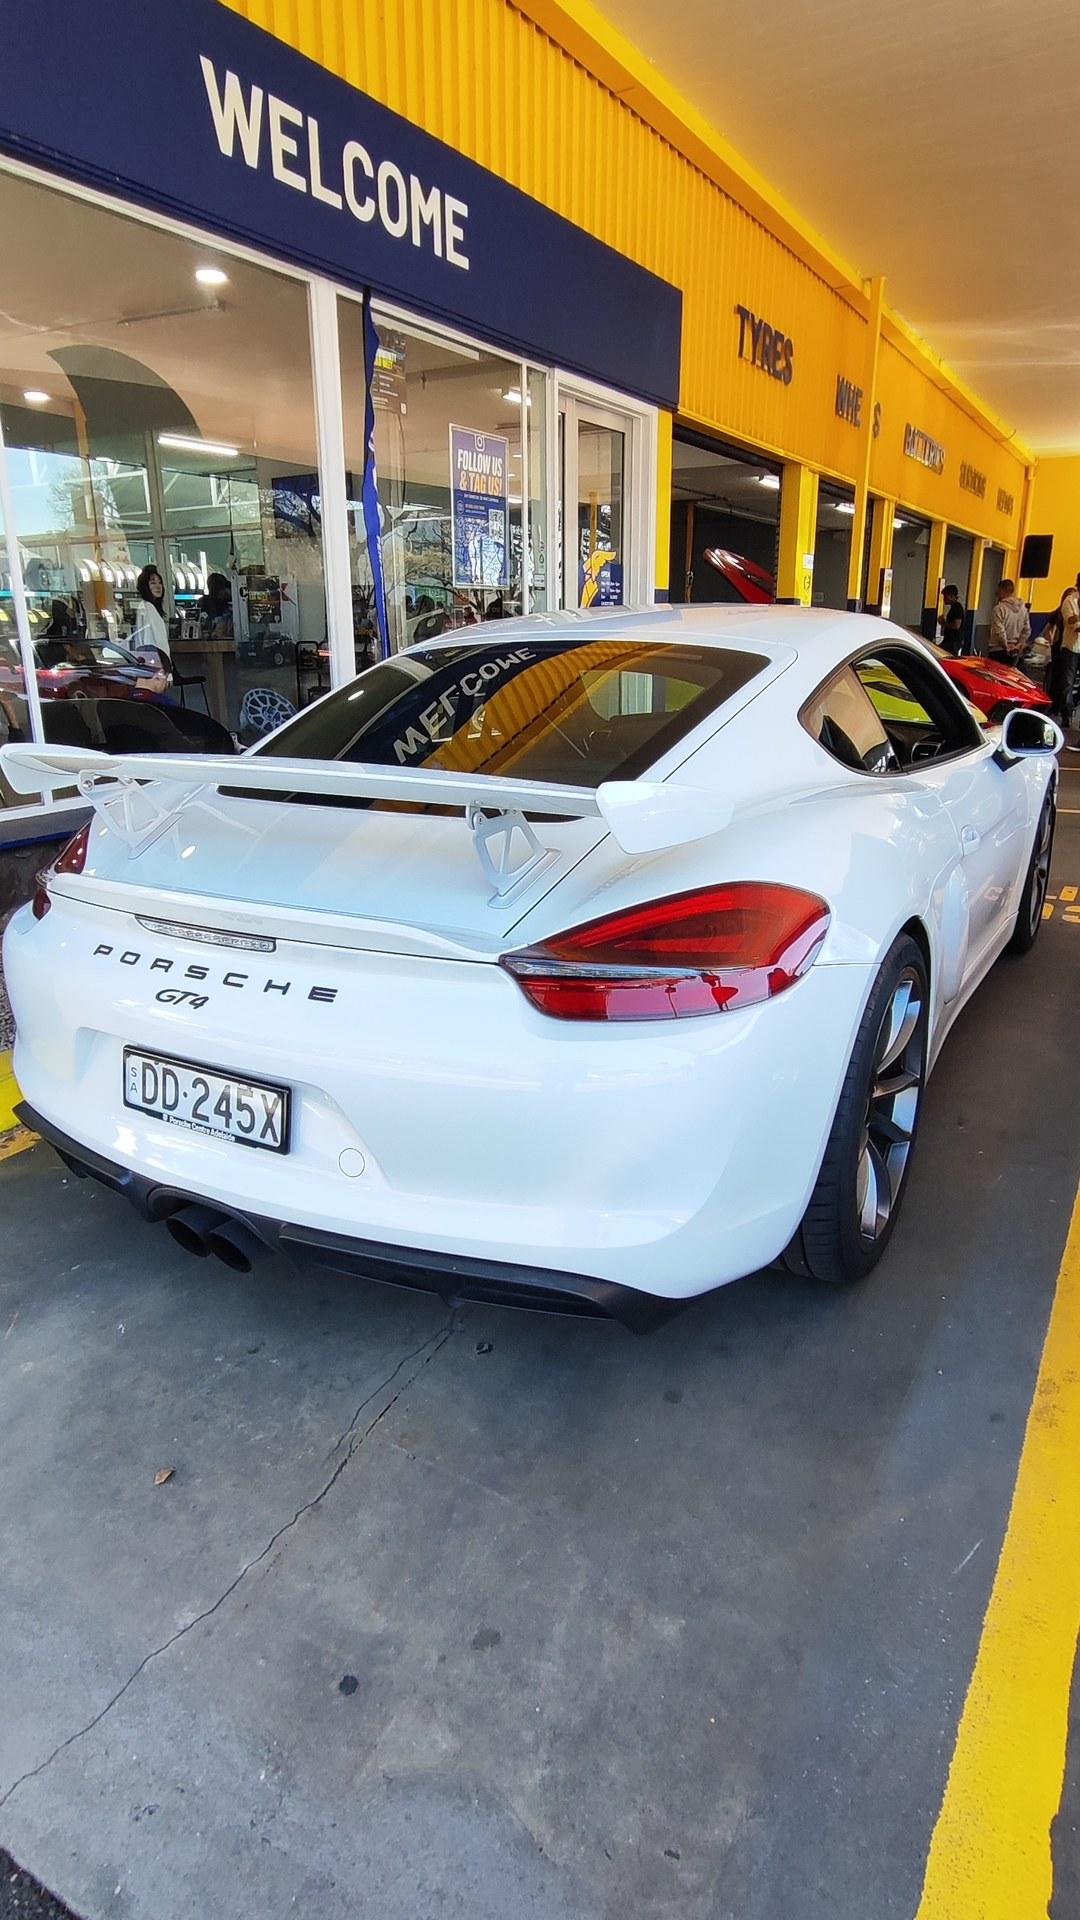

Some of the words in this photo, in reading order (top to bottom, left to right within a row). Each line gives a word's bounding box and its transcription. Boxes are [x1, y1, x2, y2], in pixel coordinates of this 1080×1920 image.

[200, 54, 469, 270] WELCOME
[736, 304, 793, 386] TYRES
[835, 373, 881, 439] WHES
[457, 448, 491, 475] FOLLOW
[492, 456, 503, 477] US
[460, 470, 467, 491] &
[469, 473, 487, 494] TAG
[488, 476, 503, 497] US!
[93, 944, 338, 1003] PORSCHE
[155, 988, 209, 1010] GT4
[169, 1116, 191, 1129] Porsche
[192, 1122, 210, 1135] Centre
[210, 1128, 236, 1142] Adelaide
